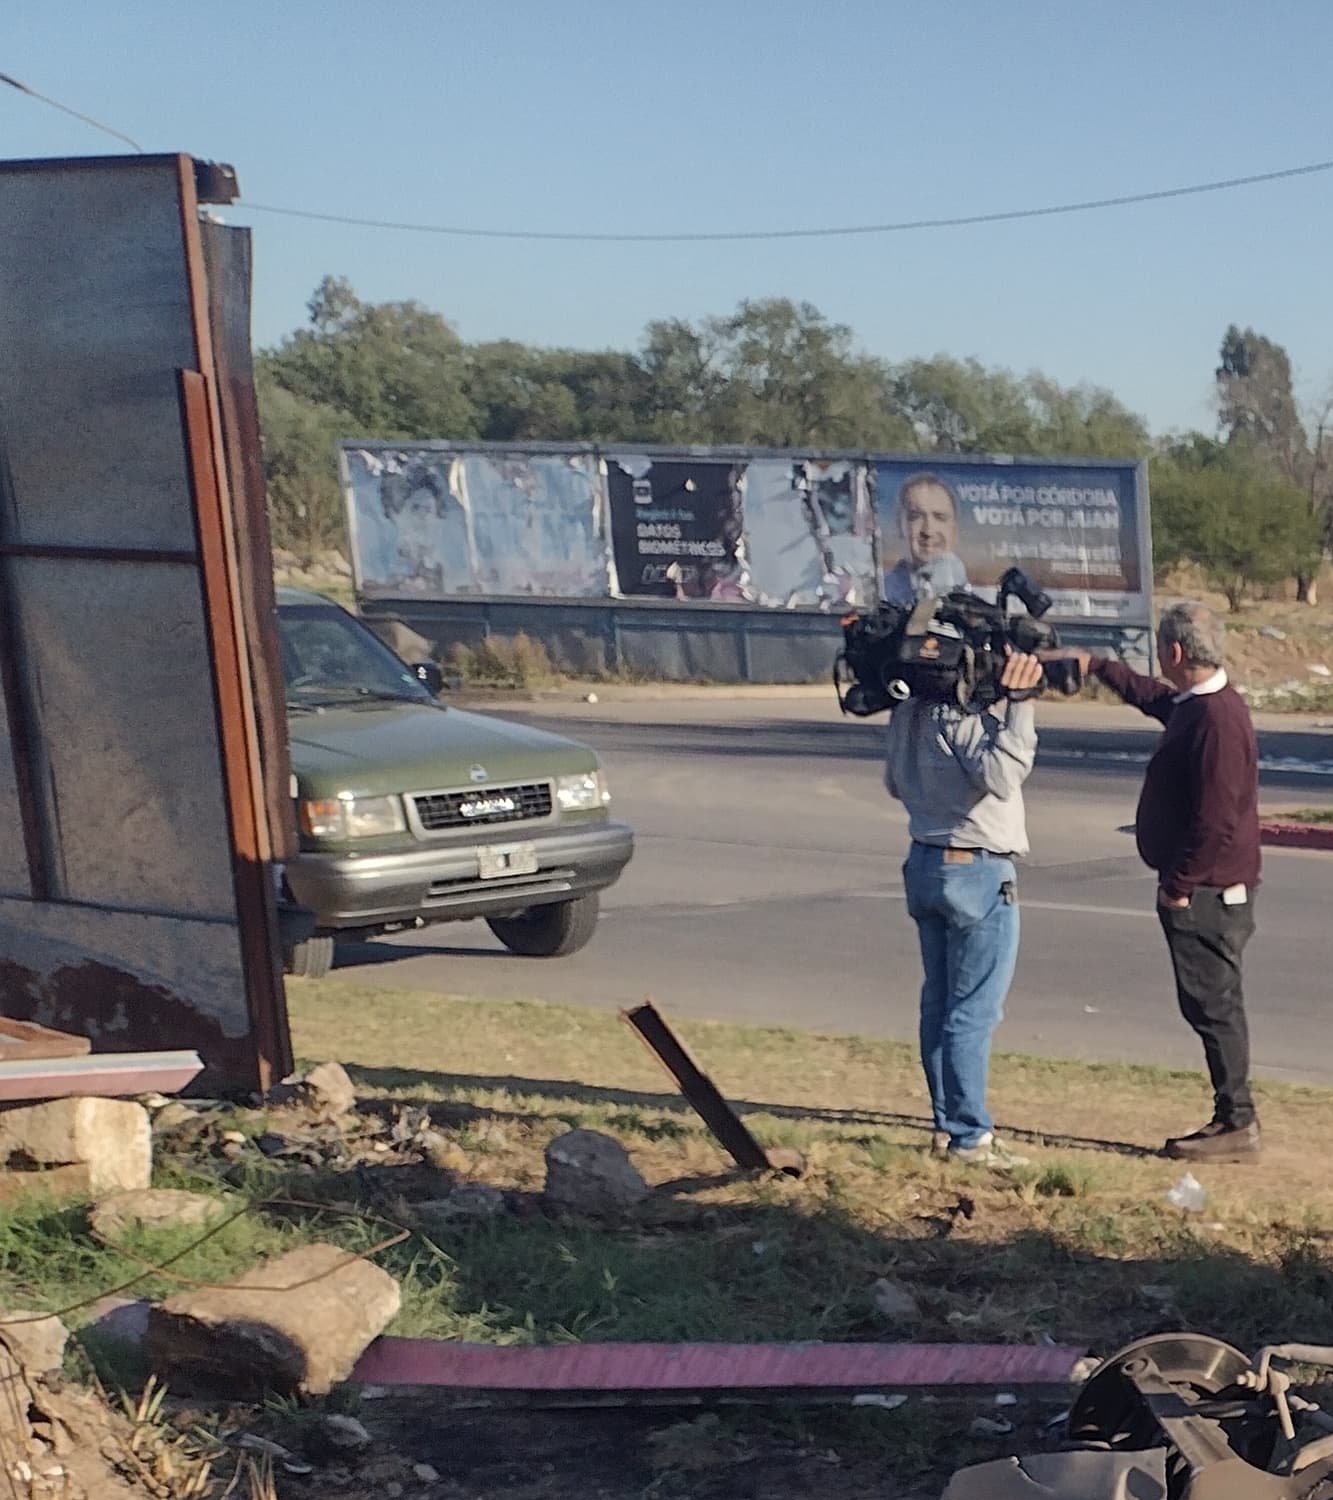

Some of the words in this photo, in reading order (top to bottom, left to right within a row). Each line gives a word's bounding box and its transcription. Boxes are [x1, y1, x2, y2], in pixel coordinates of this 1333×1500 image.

[1000, 484, 1035, 504] POR
[1037, 483, 1118, 507] CÓRDOBA
[973, 505, 1026, 526] VOTÁ
[1027, 508, 1064, 529] POR
[1067, 509, 1119, 529] JUAN
[637, 522, 682, 539] DATOS
